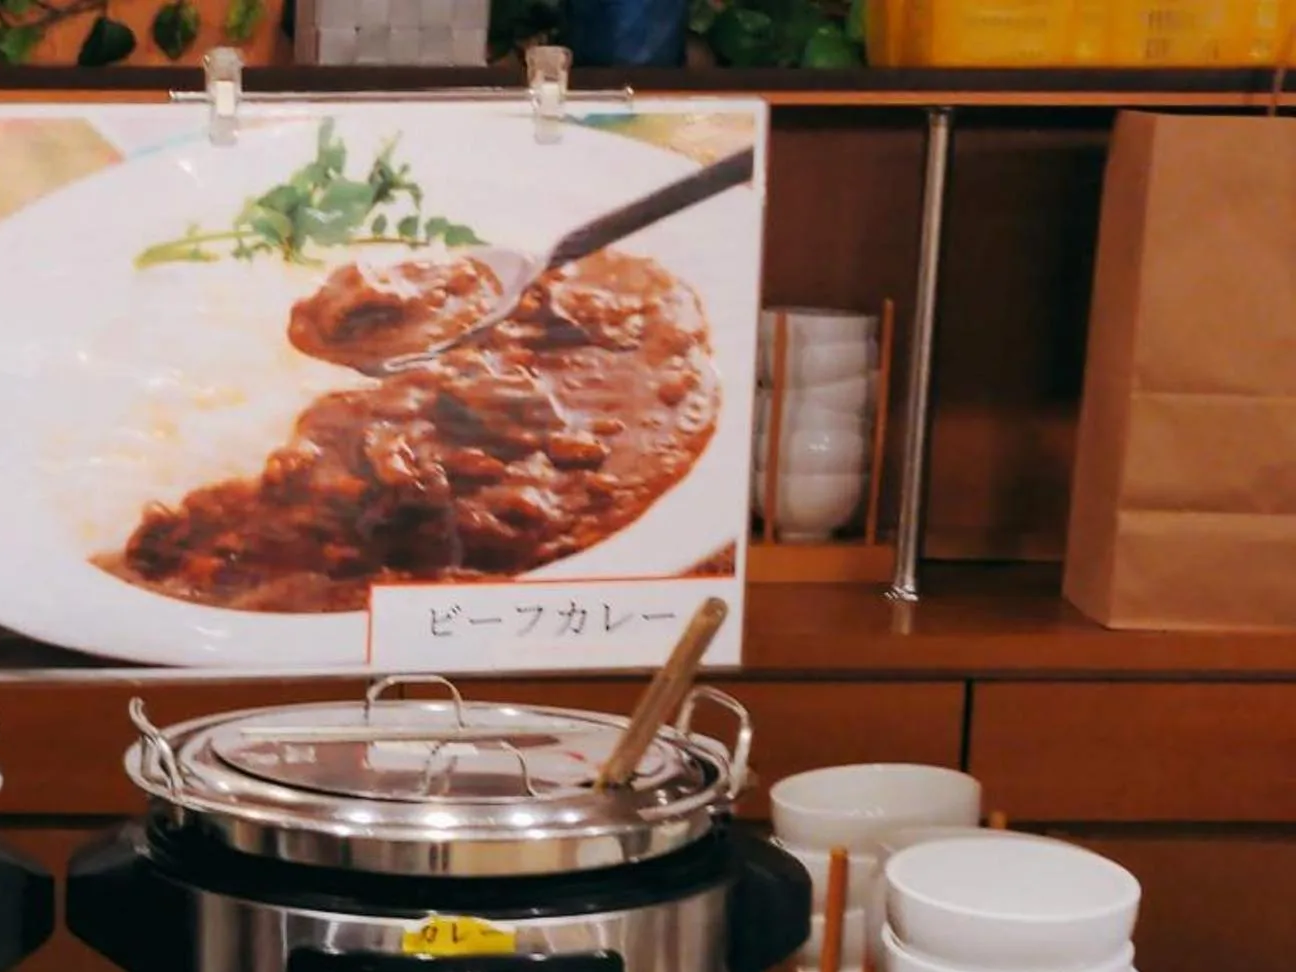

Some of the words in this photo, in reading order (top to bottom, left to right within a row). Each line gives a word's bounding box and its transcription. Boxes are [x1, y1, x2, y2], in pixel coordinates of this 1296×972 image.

[430, 601, 675, 636] ビーフカレー
